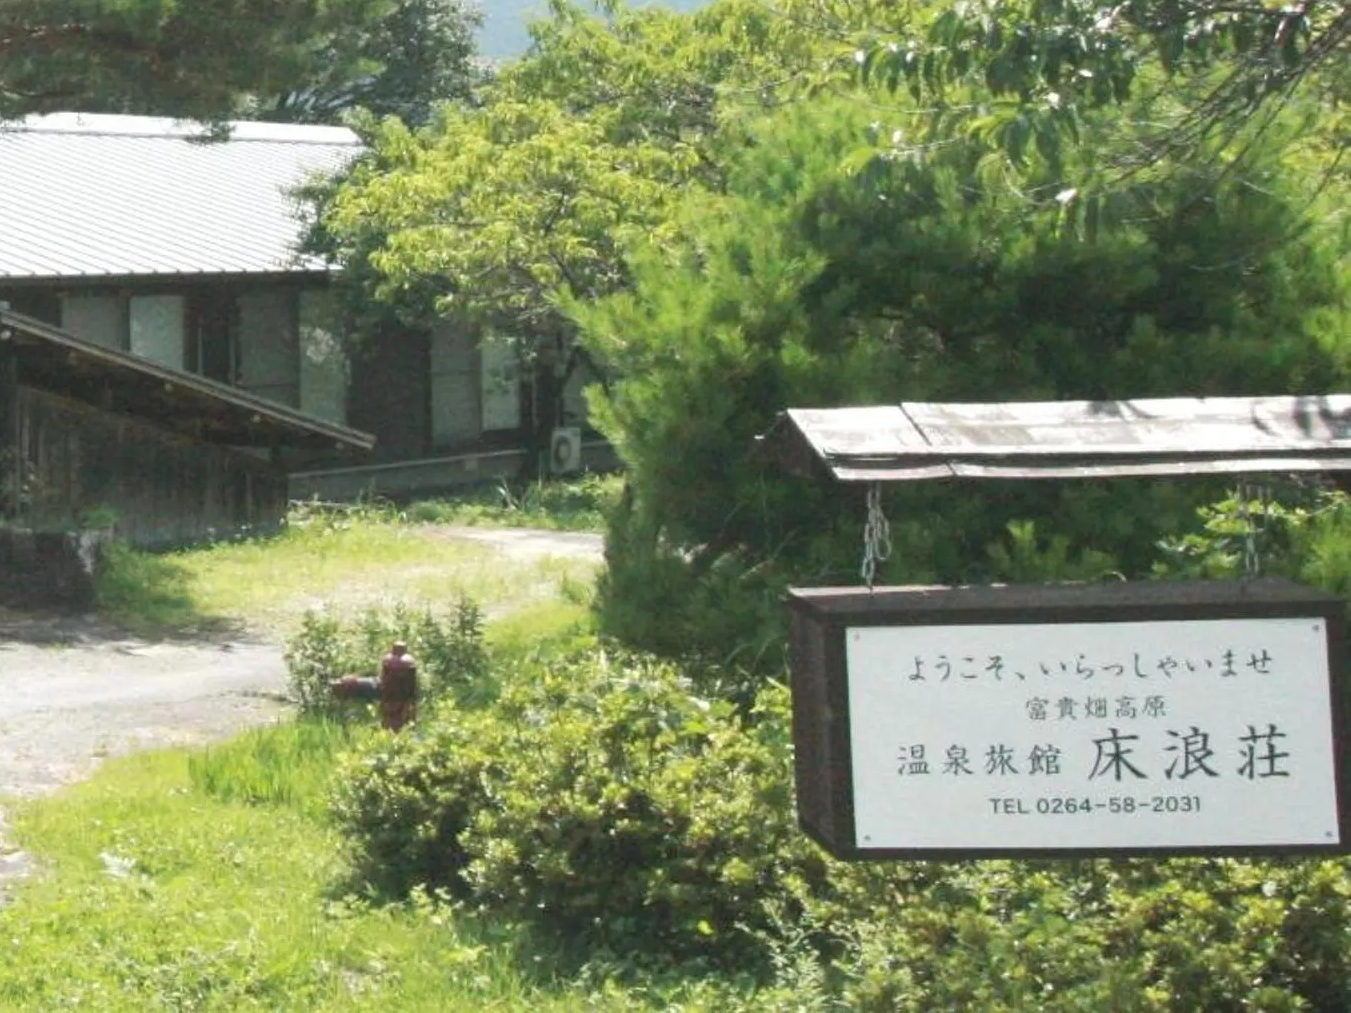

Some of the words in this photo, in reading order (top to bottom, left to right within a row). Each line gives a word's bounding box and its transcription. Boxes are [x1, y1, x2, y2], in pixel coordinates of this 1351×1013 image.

[1025, 694, 1168, 721] 富貴畑高原
[896, 742, 1063, 777] 温泉旅館
[1087, 722, 1292, 783] 床浪荘
[988, 797, 1030, 815] TEL
[1035, 795, 1202, 815] 0264-58-2031
